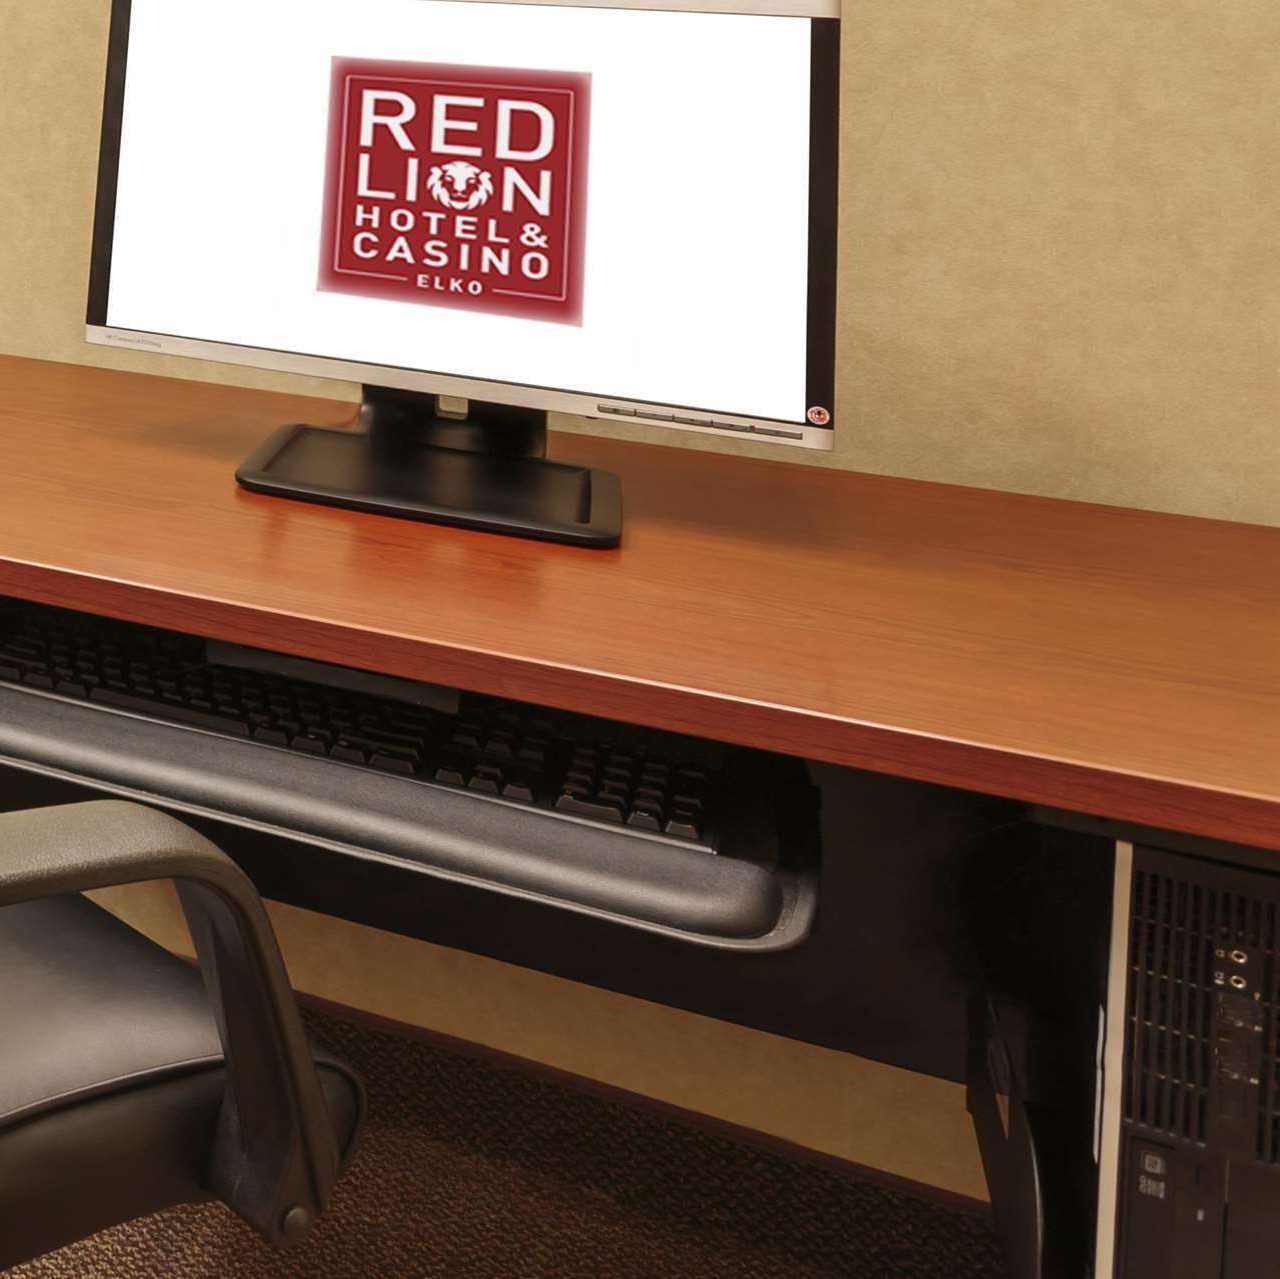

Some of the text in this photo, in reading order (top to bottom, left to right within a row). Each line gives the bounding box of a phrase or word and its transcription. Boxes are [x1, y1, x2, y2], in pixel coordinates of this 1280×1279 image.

[359, 89, 555, 162] RED
[352, 231, 549, 280] CASINO
[416, 273, 483, 296] ELKO
